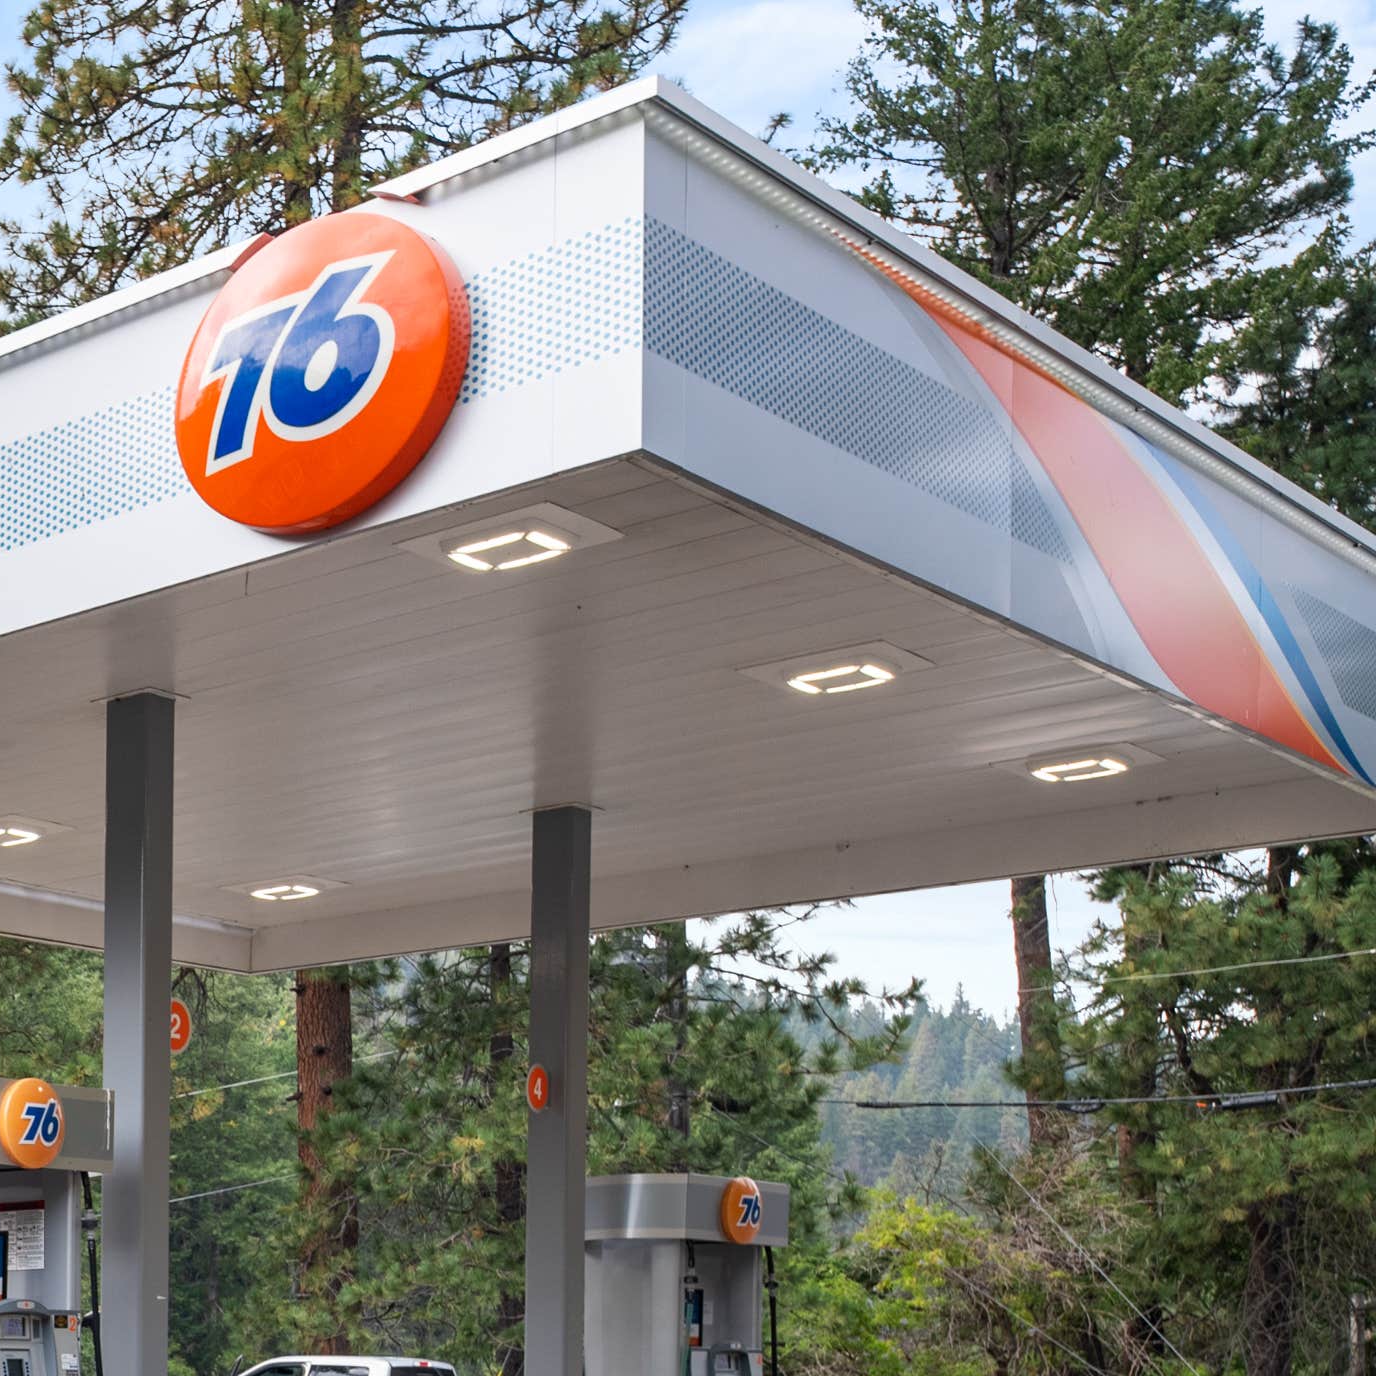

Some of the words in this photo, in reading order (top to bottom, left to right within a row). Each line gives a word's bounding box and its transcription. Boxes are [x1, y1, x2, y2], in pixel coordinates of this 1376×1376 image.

[200, 249, 396, 476] 76
[170, 1012, 181, 1040] 2
[533, 1077, 543, 1101] 4
[19, 1098, 62, 1146] 76
[737, 1194, 762, 1228] 76
[68, 1316, 77, 1332] 2
